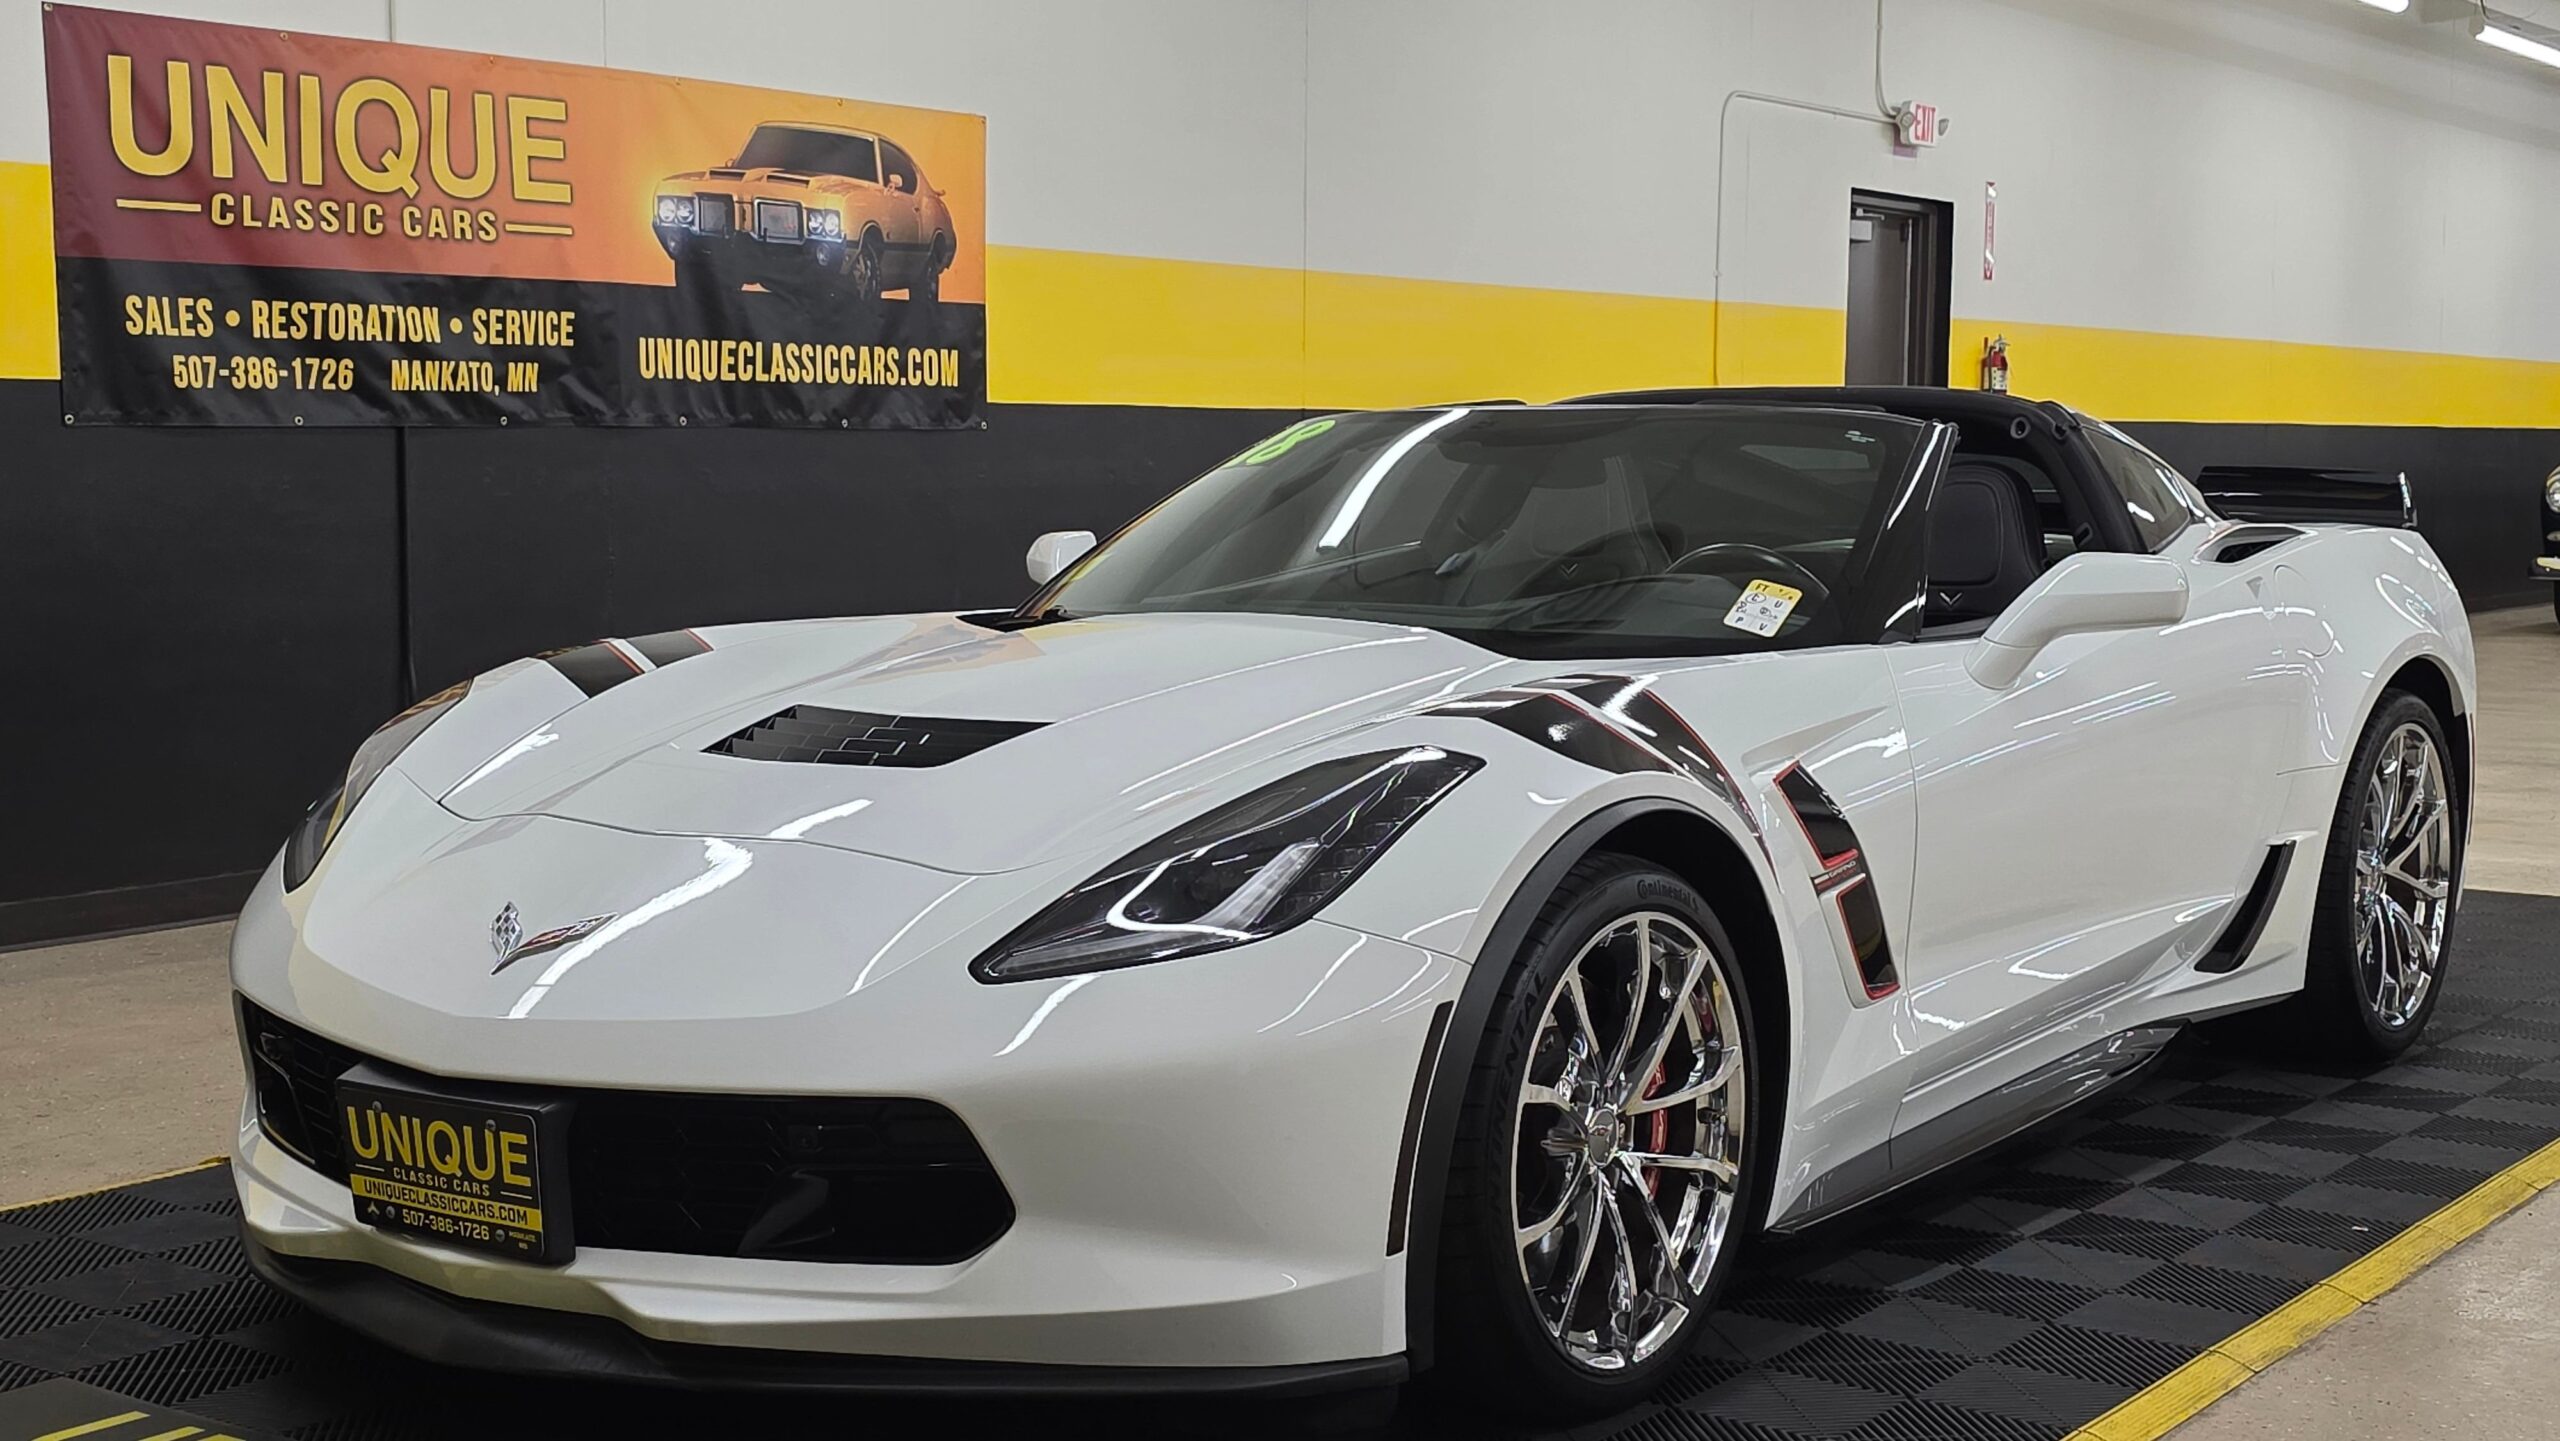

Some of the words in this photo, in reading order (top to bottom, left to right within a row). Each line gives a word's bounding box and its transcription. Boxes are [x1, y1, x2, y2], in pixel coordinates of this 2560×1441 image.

[107, 54, 573, 204] UNIQUE
[1915, 104, 1936, 143] EXIT
[211, 193, 384, 236] CLASSIC
[403, 206, 498, 242] CARS
[125, 295, 214, 338] SALES
[252, 301, 442, 344] RESTORATION
[472, 309, 576, 347] SERVICE
[173, 354, 354, 391] 507-386-1726
[391, 360, 501, 396] MANKATO,
[507, 362, 539, 393] MN
[639, 336, 959, 387] UNIQUECLASSICCARS.COM
[346, 1105, 532, 1188] UNIQUE
[363, 1178, 529, 1226] UNIQUECLASSICCARS.COM
[393, 1166, 448, 1190] CLASSIC
[453, 1178, 491, 1197] CARS
[402, 1208, 490, 1241] 507-386-1726
